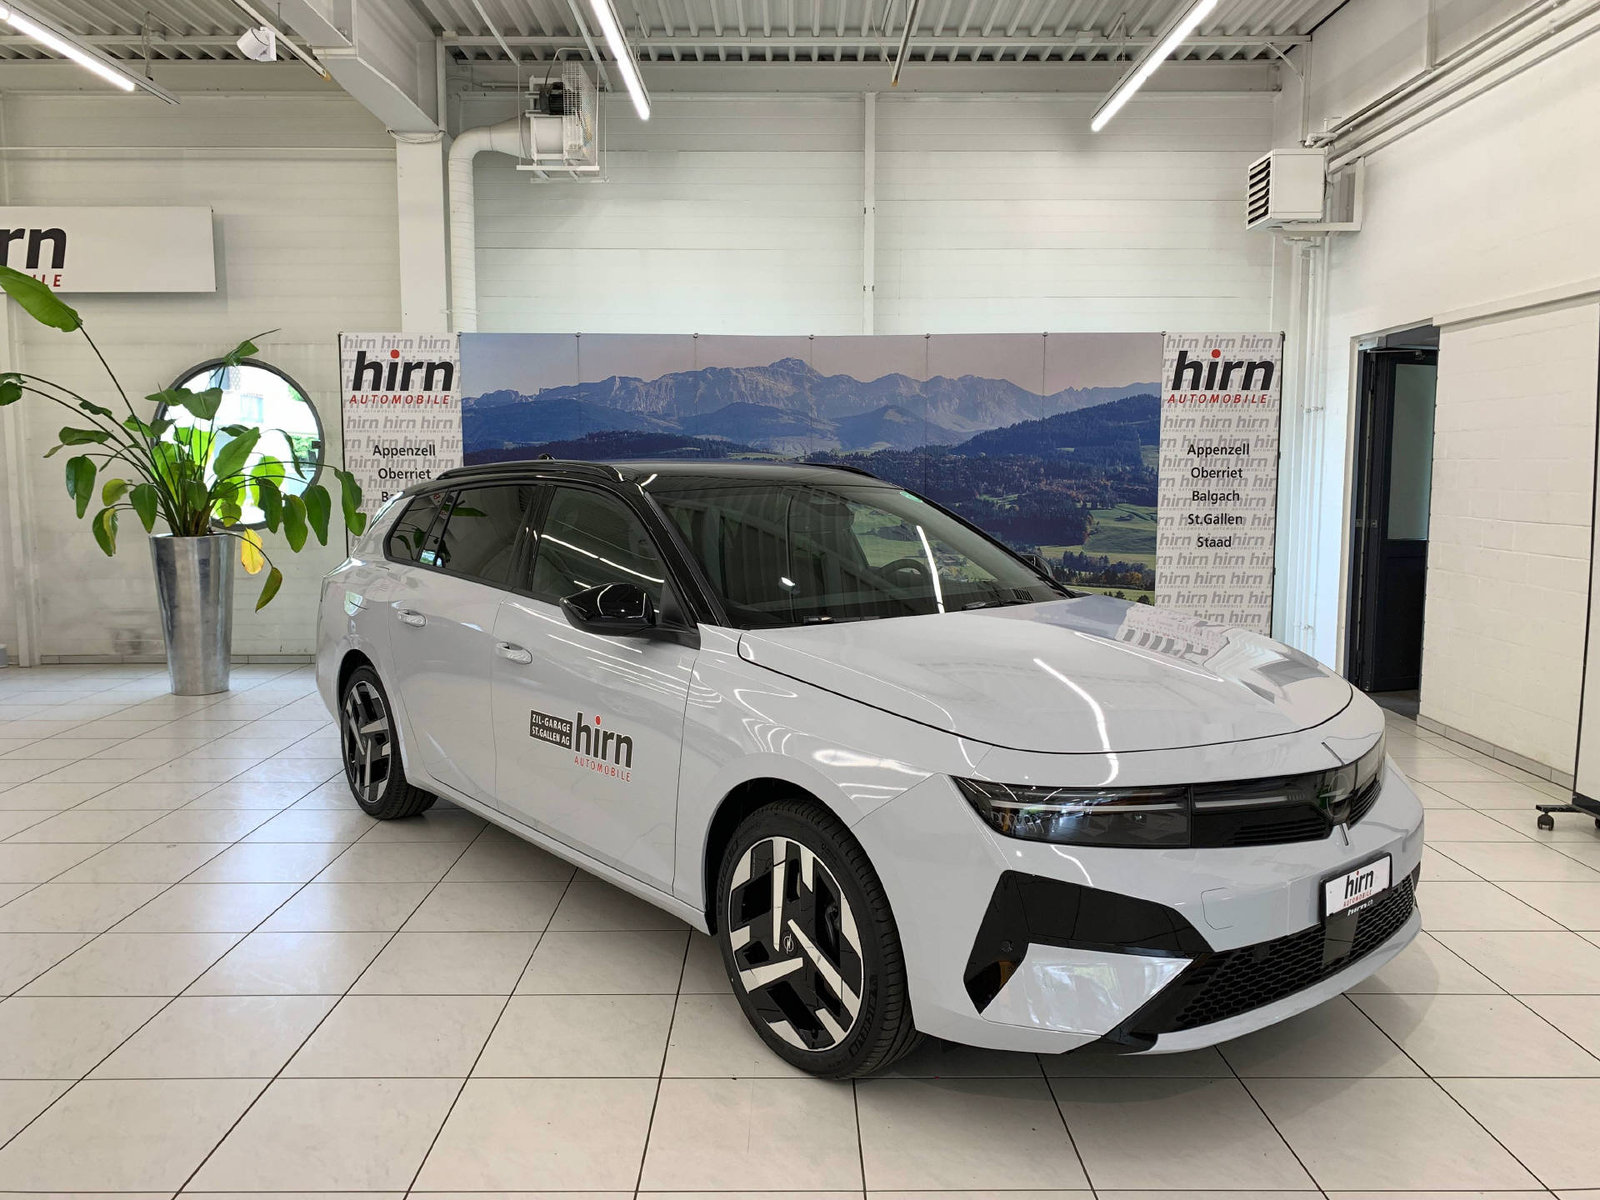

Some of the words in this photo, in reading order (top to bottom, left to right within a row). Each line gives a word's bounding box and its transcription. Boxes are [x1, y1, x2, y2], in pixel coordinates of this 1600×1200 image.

[343, 335, 376, 349] hirn
[381, 335, 413, 349] hirn
[418, 335, 451, 349] hirn
[1166, 335, 1199, 349] hirn
[1203, 335, 1236, 349] hirn
[1240, 335, 1273, 349] hirn
[352, 349, 454, 391] hirn
[1171, 349, 1275, 391] hirn
[349, 394, 450, 405] AUTOMOBILE
[1167, 394, 1268, 404] AUTOMOBILE
[346, 415, 379, 429] hirn
[383, 415, 416, 429] hirn
[421, 415, 453, 429] hirn
[1163, 415, 1196, 428] hirn
[1200, 415, 1232, 428] hirn
[1236, 415, 1269, 428] hirn
[372, 444, 436, 458] Appenzell
[1187, 443, 1250, 458] Appenzell
[348, 456, 380, 469] hirn
[1162, 455, 1194, 468] hirn
[1234, 455, 1268, 468] hirn
[378, 467, 432, 480] Oberriet
[1190, 466, 1243, 479] Oberriet
[1191, 489, 1240, 504] Balgach
[1187, 513, 1243, 525] St.Gallen
[1159, 533, 1191, 546] hirn
[1196, 536, 1232, 548] Staad
[1176, 552, 1209, 566] hirn
[1212, 552, 1245, 566] hirn
[1158, 571, 1190, 585] hirn
[1194, 571, 1226, 585] hirn
[1230, 571, 1263, 585] hirn
[1175, 590, 1207, 604] hirn
[1210, 590, 1244, 604] hirn
[1228, 610, 1262, 623] hirn
[531, 714, 571, 734] ZIL-GARAGE
[531, 725, 561, 743] ST.GALLEN
[561, 735, 570, 746] AG
[575, 711, 633, 769] hirn
[574, 755, 631, 782] AUTOMOBILE
[1344, 870, 1374, 900] hirn
